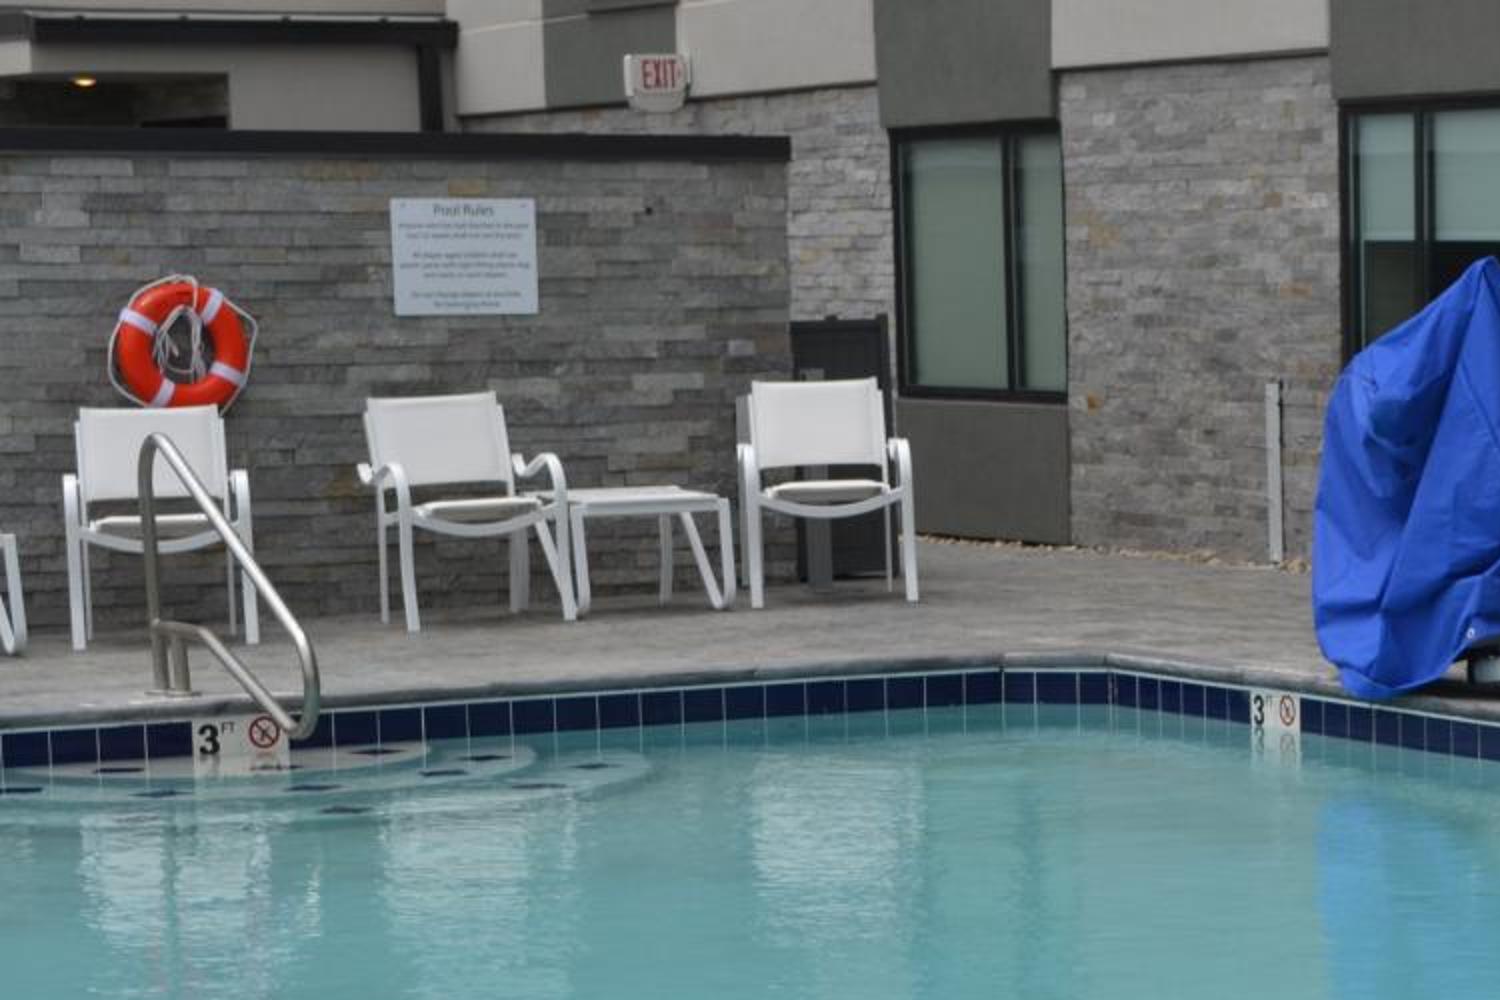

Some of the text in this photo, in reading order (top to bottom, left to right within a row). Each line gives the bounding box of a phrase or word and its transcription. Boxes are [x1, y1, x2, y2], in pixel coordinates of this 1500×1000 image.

[641, 59, 676, 89] EXIT
[1253, 694, 1265, 725] 3
[198, 724, 220, 755] 3
